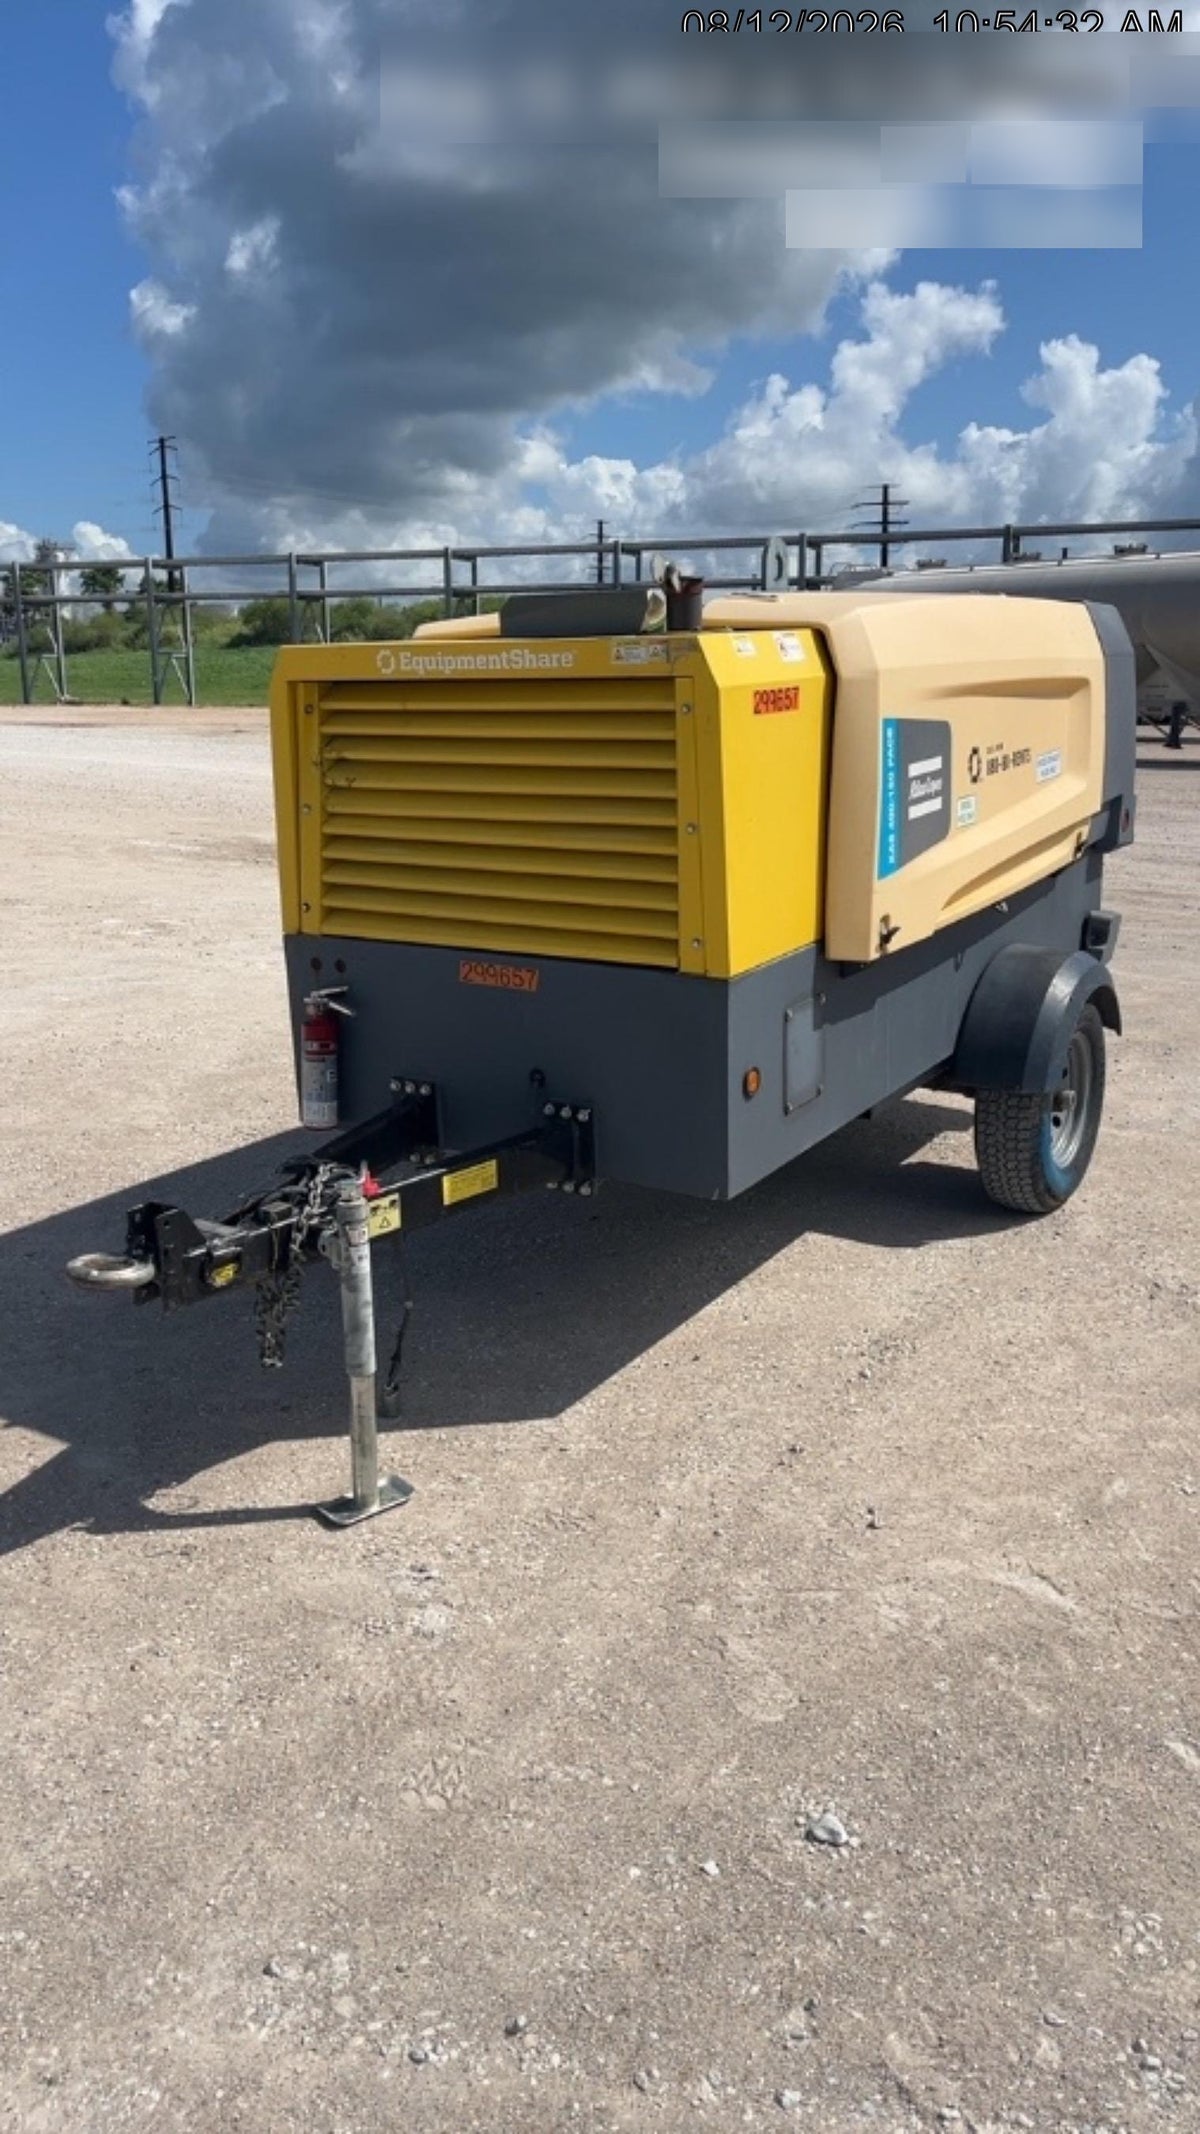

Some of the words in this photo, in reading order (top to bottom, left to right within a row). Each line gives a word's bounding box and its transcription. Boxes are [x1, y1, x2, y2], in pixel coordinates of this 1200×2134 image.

[399, 650, 575, 675] EquipmentShare
[753, 687, 800, 714] 299657
[461, 962, 537, 990] 299657
